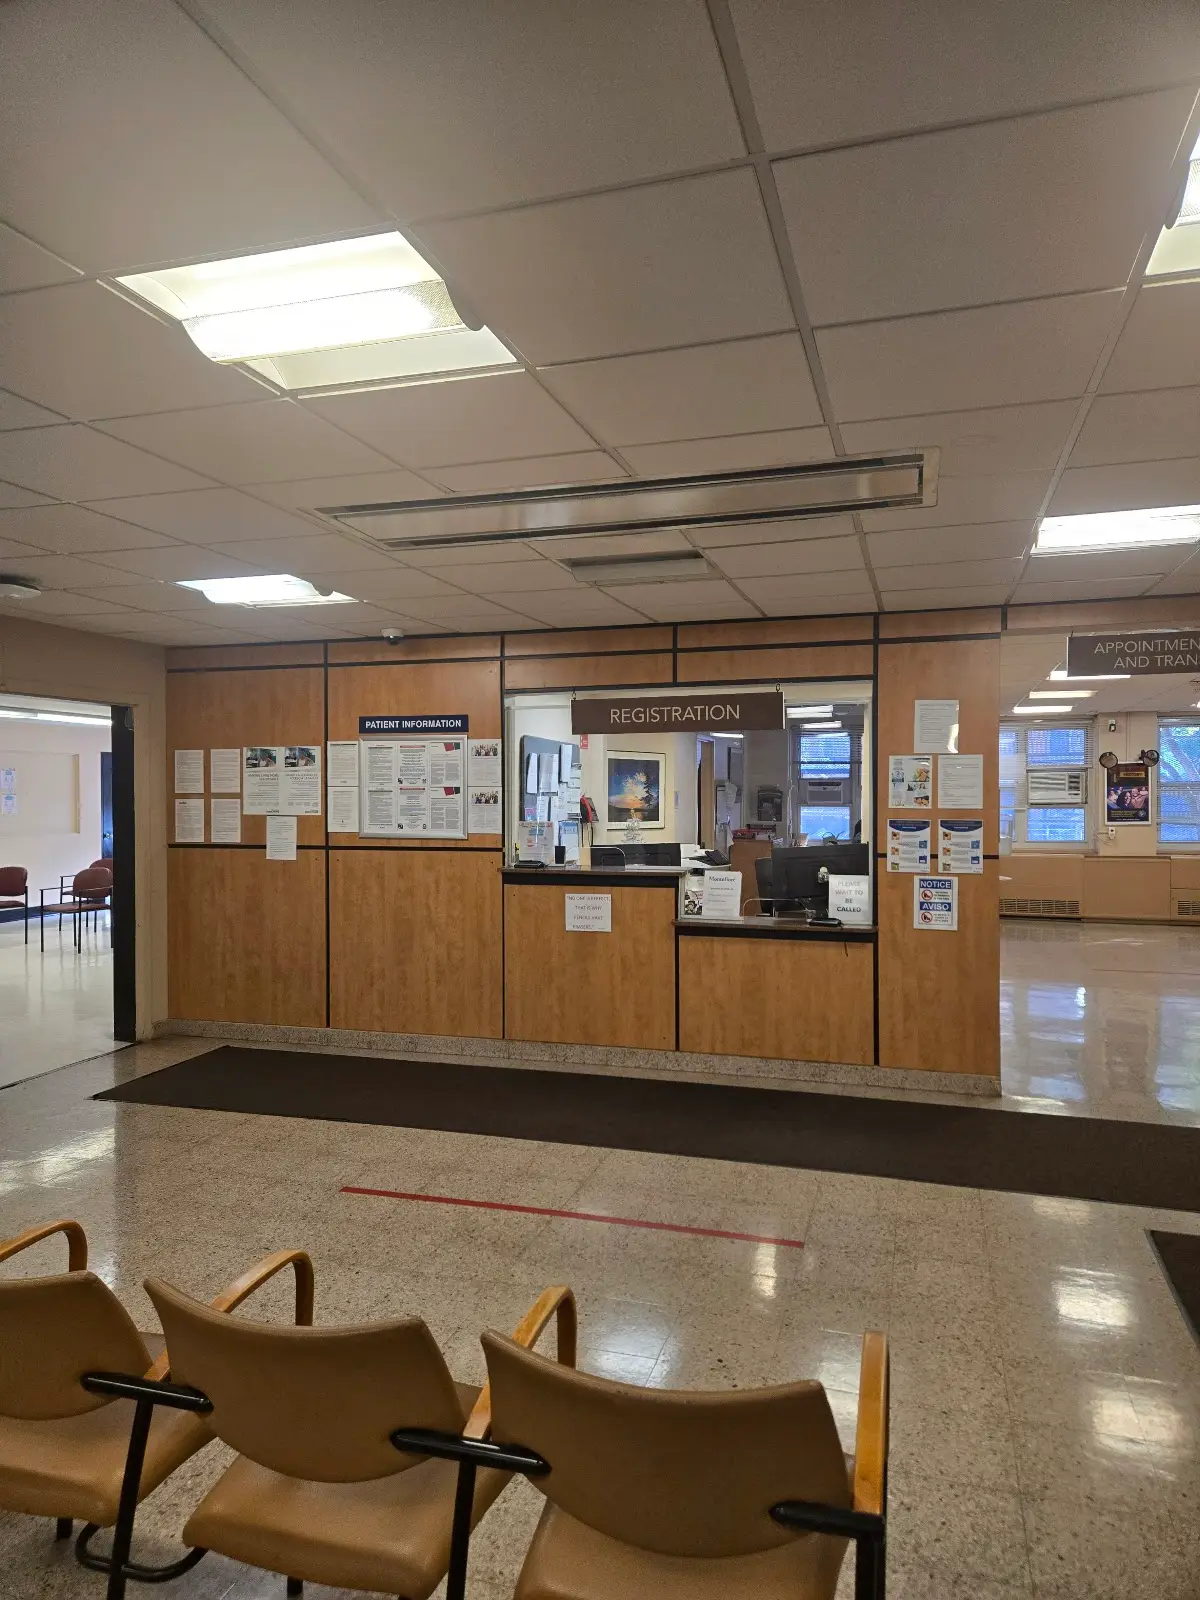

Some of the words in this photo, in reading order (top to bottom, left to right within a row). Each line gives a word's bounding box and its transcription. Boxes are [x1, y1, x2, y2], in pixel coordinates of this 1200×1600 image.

[1113, 656, 1150, 669] AND
[1154, 653, 1200, 667] TRAN
[610, 704, 740, 724] REGISTRATION
[365, 720, 400, 729] PATIENT
[402, 719, 462, 728] INFORMATION
[920, 880, 951, 889] NOTICE
[922, 902, 950, 911] AVISO
